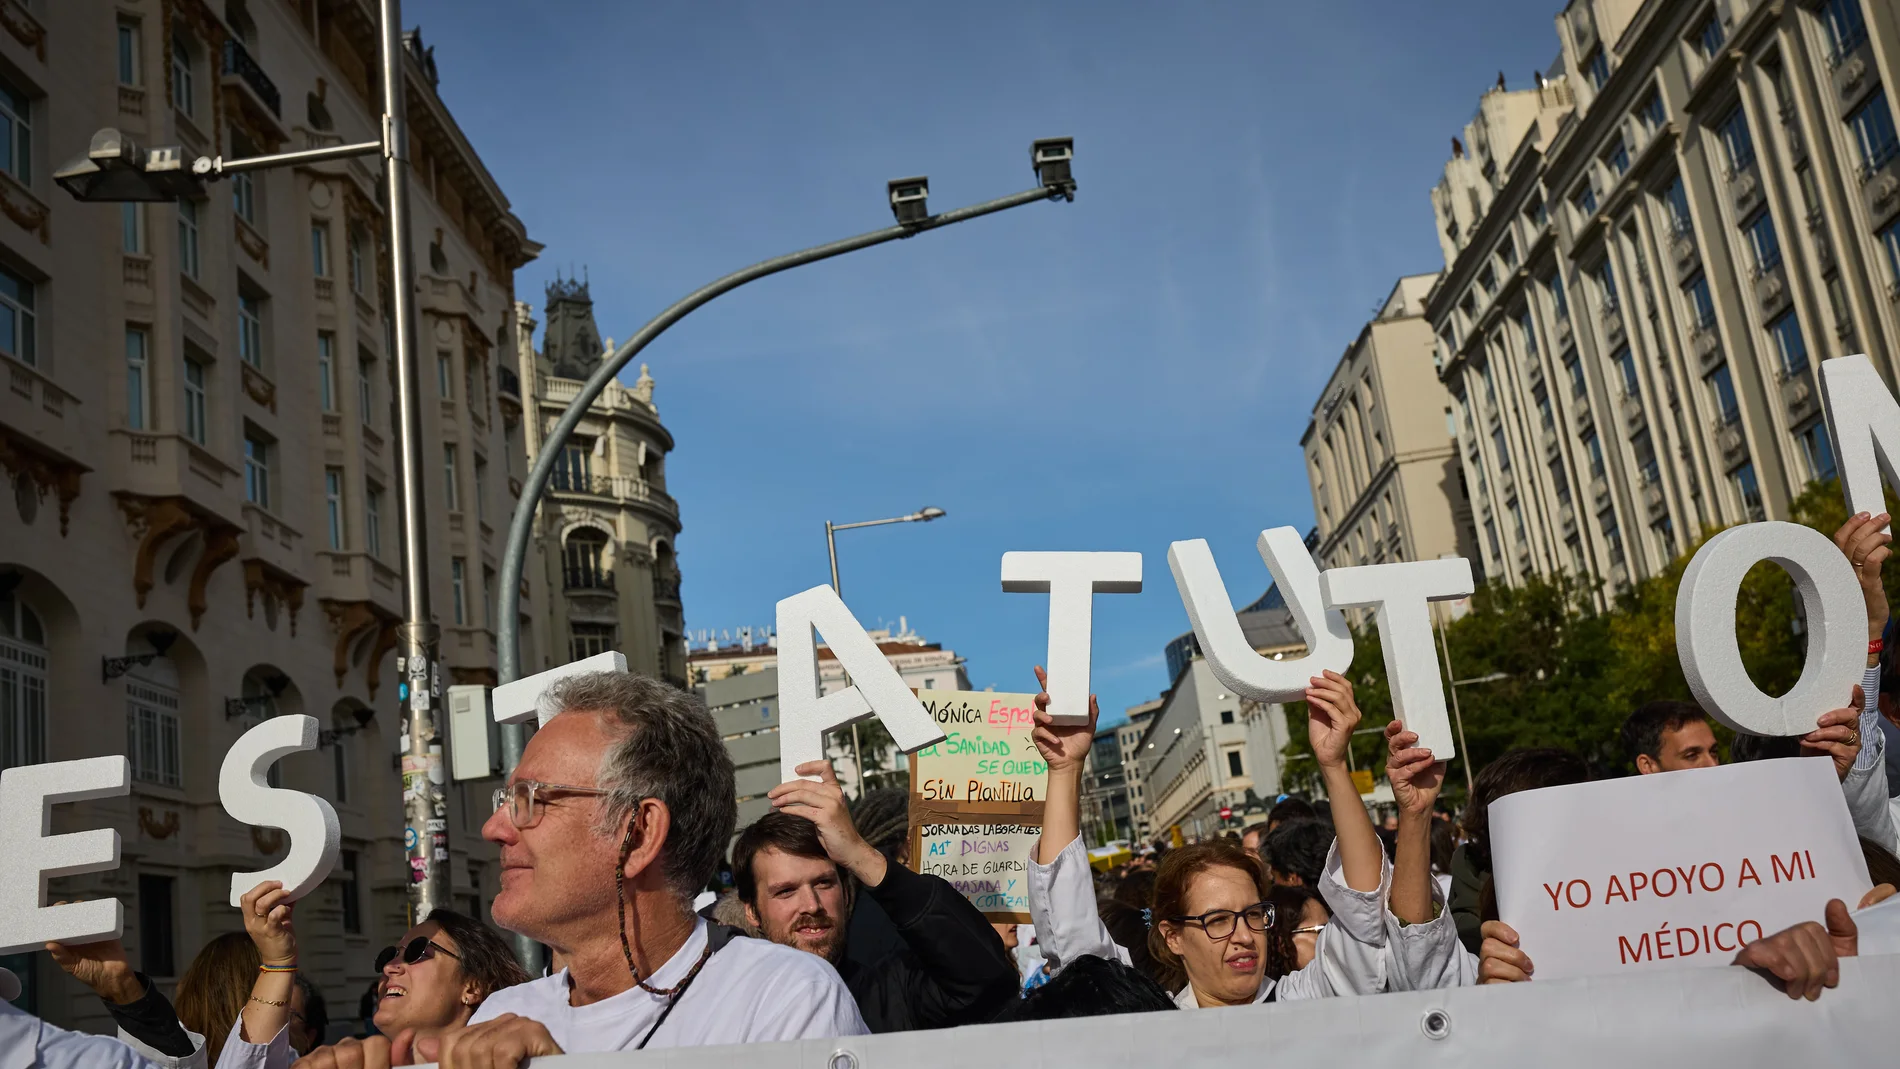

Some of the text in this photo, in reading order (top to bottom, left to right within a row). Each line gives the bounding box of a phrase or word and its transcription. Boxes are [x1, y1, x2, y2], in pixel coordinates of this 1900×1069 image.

[976, 760, 999, 774] SE
[921, 823, 1041, 837] JORNADAS LABORALES
[960, 840, 1009, 857] DIGNAS
[923, 860, 958, 877] HORA
[962, 863, 979, 875] DE
[1543, 850, 1816, 911] YO APOYO A MI
[1618, 919, 1763, 965] MÉDICO
